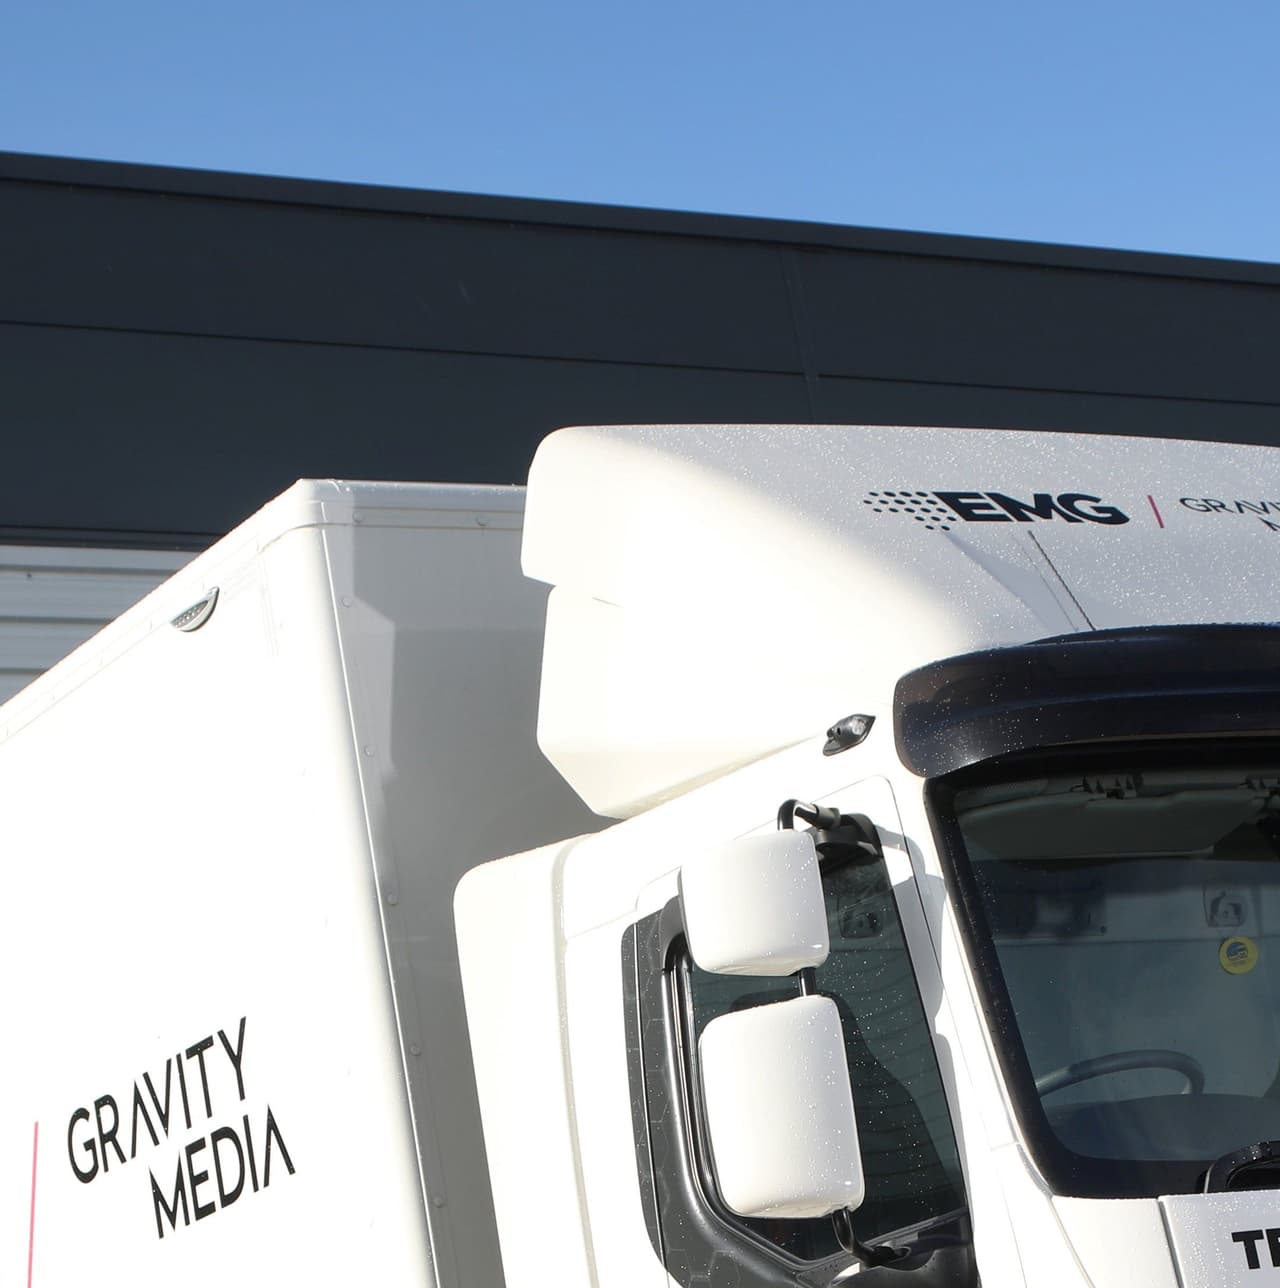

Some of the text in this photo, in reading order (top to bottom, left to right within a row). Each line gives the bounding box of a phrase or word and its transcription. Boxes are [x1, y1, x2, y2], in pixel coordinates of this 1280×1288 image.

[931, 491, 1130, 525] EMG
[67, 1016, 247, 1184] GRAVITY
[149, 1104, 296, 1239] MEDIA
